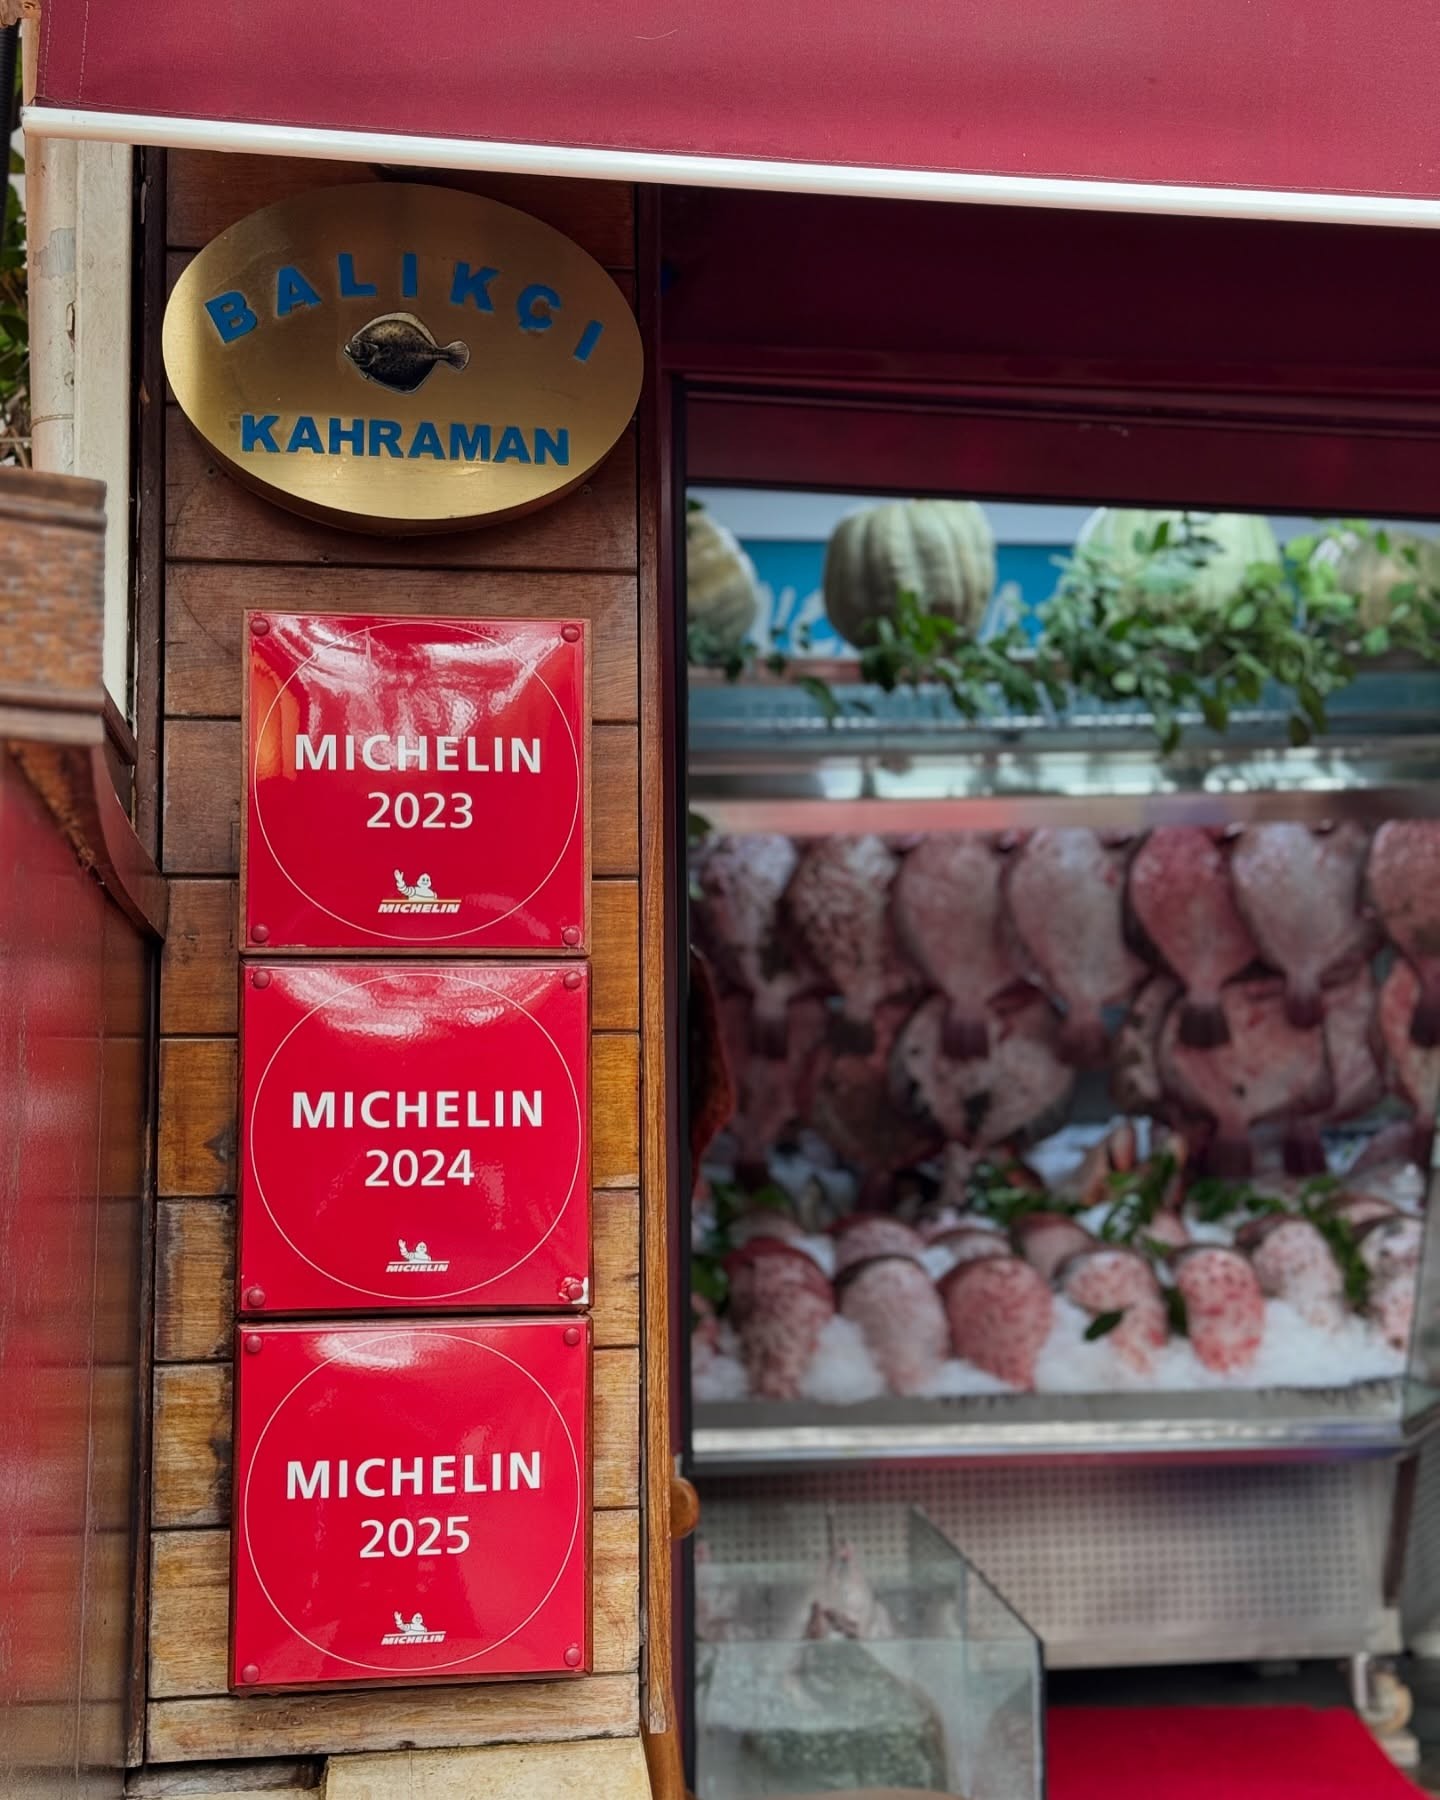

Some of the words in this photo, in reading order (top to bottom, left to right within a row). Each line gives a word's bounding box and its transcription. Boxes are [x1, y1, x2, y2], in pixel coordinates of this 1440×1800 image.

[205, 252, 604, 362] BALIKÇI
[241, 414, 570, 466] KAHRAMAN
[295, 734, 541, 773] MICHELIN
[366, 792, 473, 829] 2023
[377, 903, 460, 914] MICHELIN
[292, 1090, 543, 1129] MICHELIN
[364, 1149, 475, 1187] 2024
[385, 1263, 449, 1272] MICHELIN
[286, 1451, 541, 1500] MICHELIN
[359, 1516, 470, 1559] 2025
[380, 1634, 446, 1646] MICHELIN
